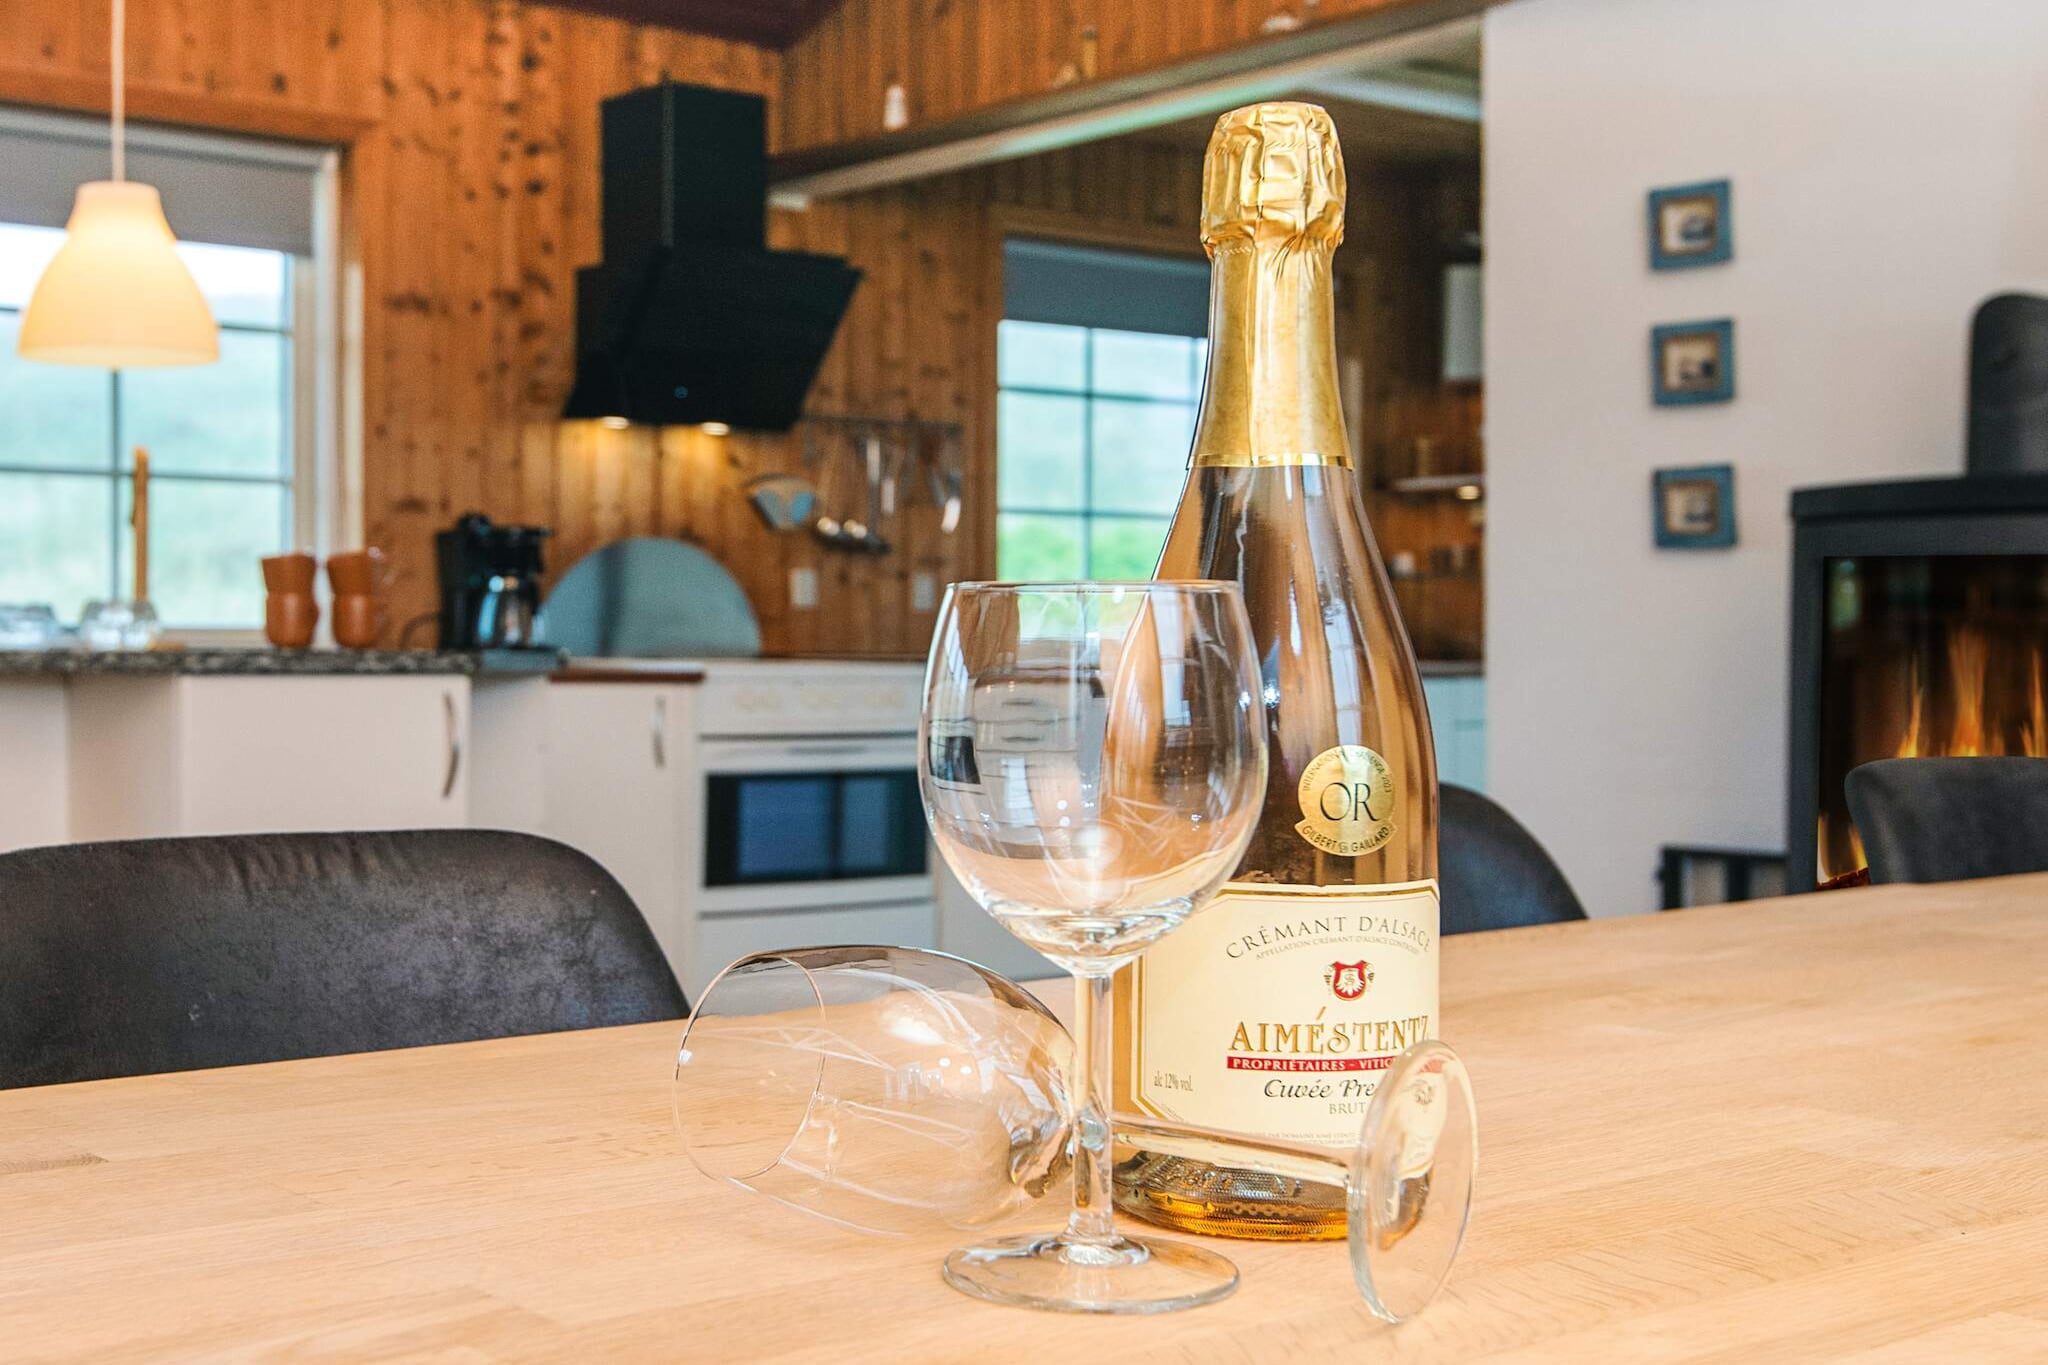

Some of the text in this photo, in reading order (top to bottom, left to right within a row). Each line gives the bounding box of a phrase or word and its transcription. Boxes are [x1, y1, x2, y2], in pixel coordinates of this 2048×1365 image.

[1320, 782, 1380, 821] OR
[1302, 824, 1338, 850] GILBERT
[1350, 826, 1390, 853] GAILLARD
[1226, 915, 1430, 959] CRÉMANT D'ALSACE
[1233, 1058, 1347, 1071] PROPRIÉTAIRES
[1264, 1078, 1375, 1099] Cuvée Pre
[1329, 1101, 1367, 1115] BRUT
